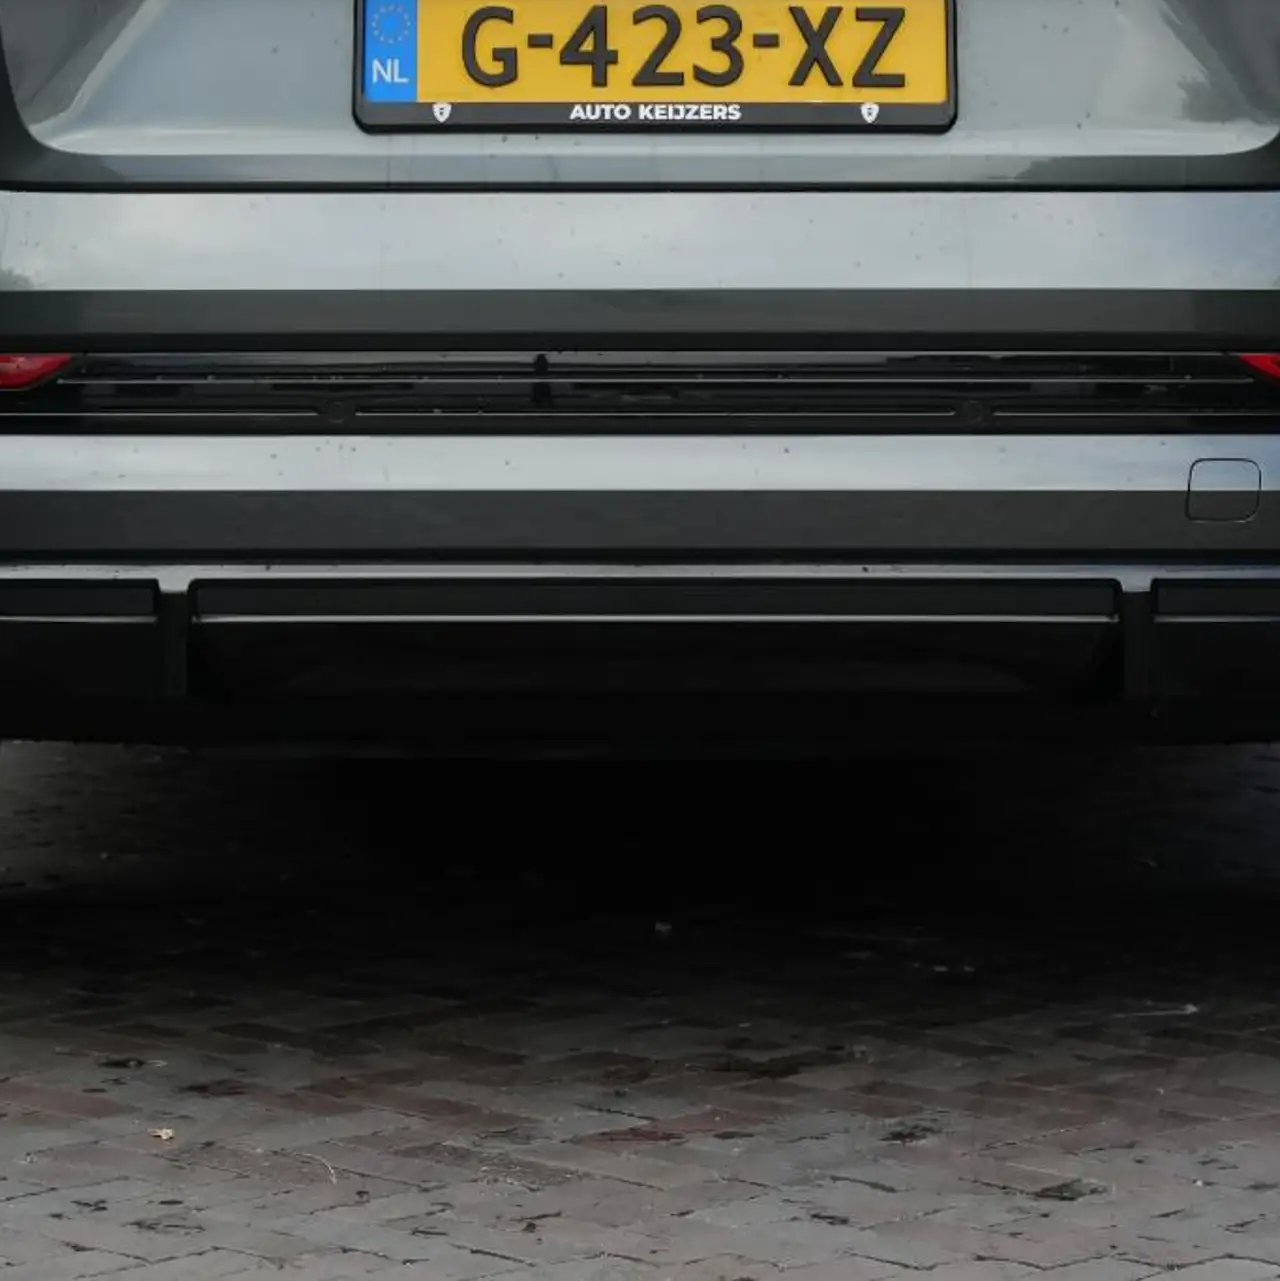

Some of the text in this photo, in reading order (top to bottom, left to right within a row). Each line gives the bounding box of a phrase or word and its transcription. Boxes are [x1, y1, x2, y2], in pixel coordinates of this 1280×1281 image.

[372, 4, 907, 88] NL G-423-XZ
[569, 104, 742, 121] AUTO KEIJZERS
